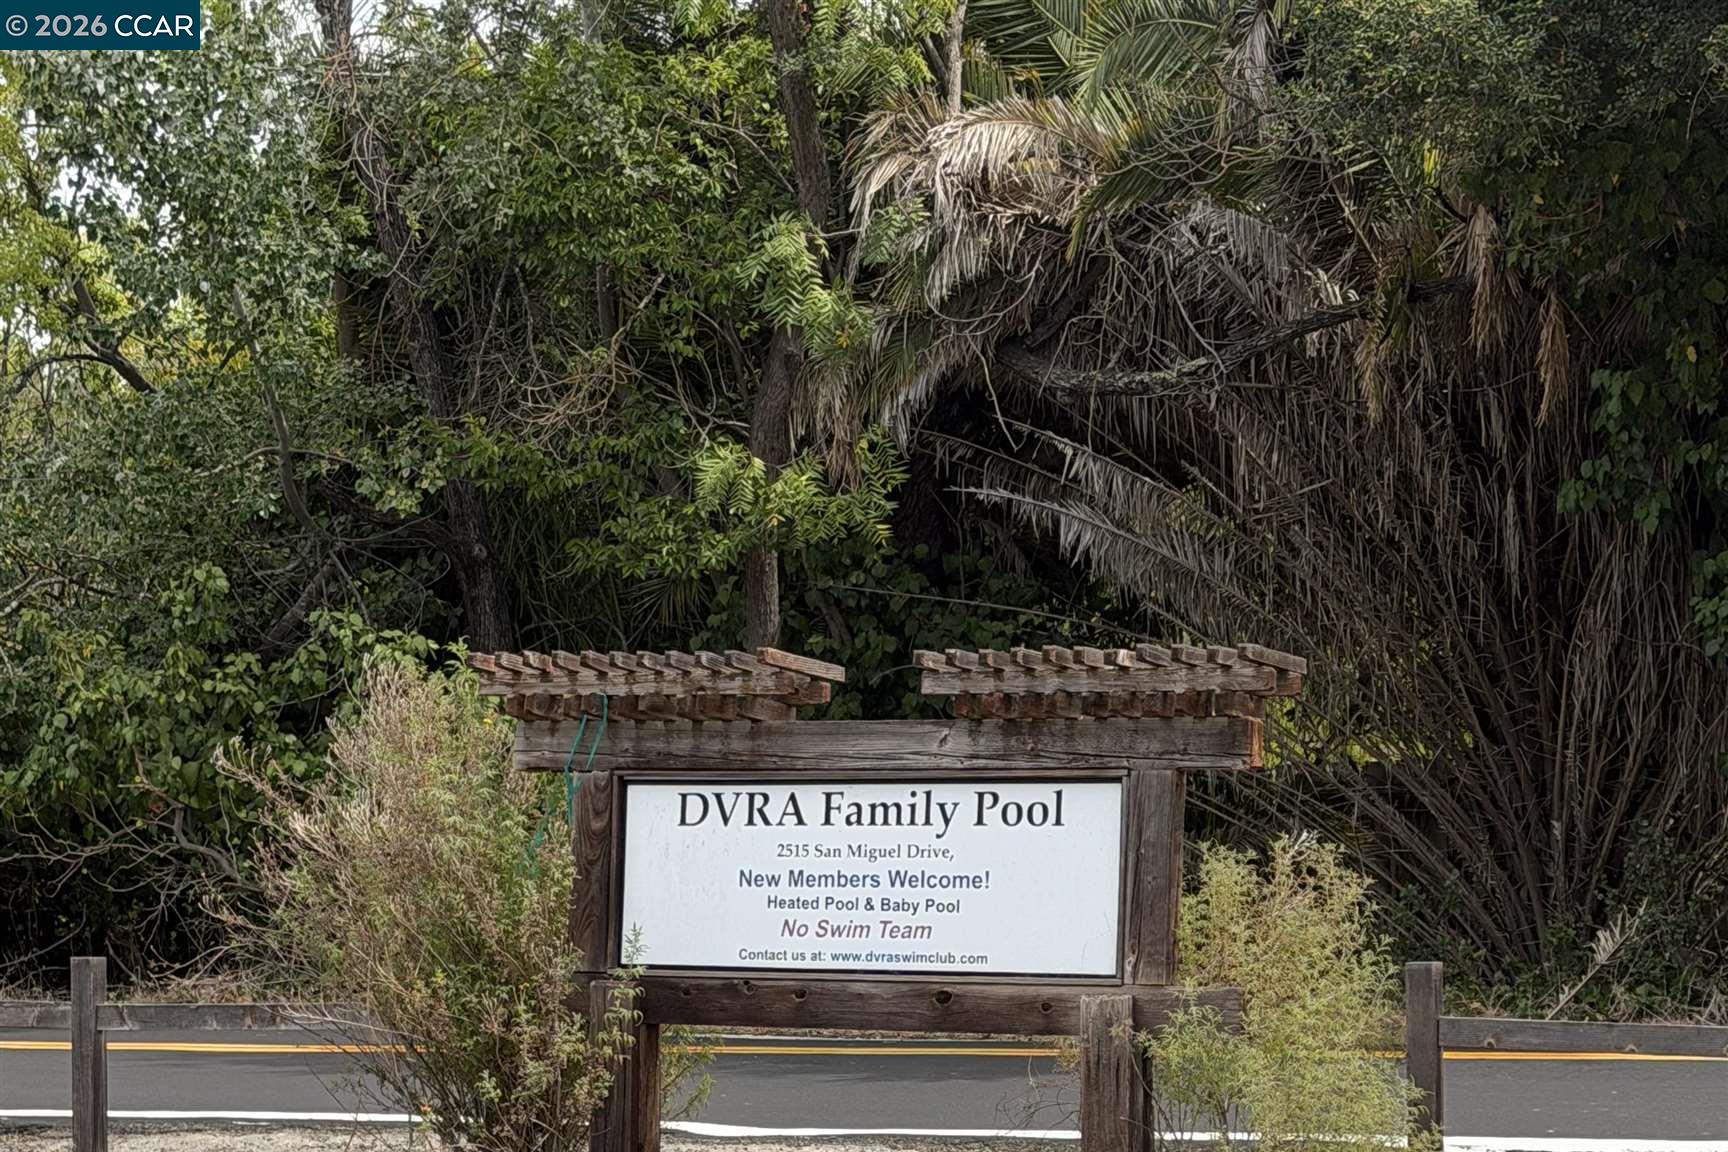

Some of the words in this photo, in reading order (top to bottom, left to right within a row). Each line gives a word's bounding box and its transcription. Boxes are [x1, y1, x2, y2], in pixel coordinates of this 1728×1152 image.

[677, 792, 808, 827] DVRA
[820, 790, 960, 839] Family
[972, 789, 1065, 827] Pool
[777, 844, 810, 858] 2515
[814, 844, 842, 858] San
[847, 844, 901, 863] Miguel
[907, 845, 954, 862] Drive,
[739, 870, 782, 888] New
[788, 870, 881, 889] Members
[887, 870, 990, 890] Welcome!
[767, 895, 820, 910] Heated
[824, 897, 859, 911] Pool
[863, 897, 875, 912] &
[880, 898, 921, 916] Baby
[925, 899, 960, 914] Pool
[780, 919, 809, 938] No
[815, 920, 871, 939] Swim
[879, 921, 933, 939] Team
[738, 949, 788, 961] Contact
[791, 953, 807, 962] us
[810, 951, 826, 962] at:
[830, 951, 988, 965] www.dvraswimclub.com
